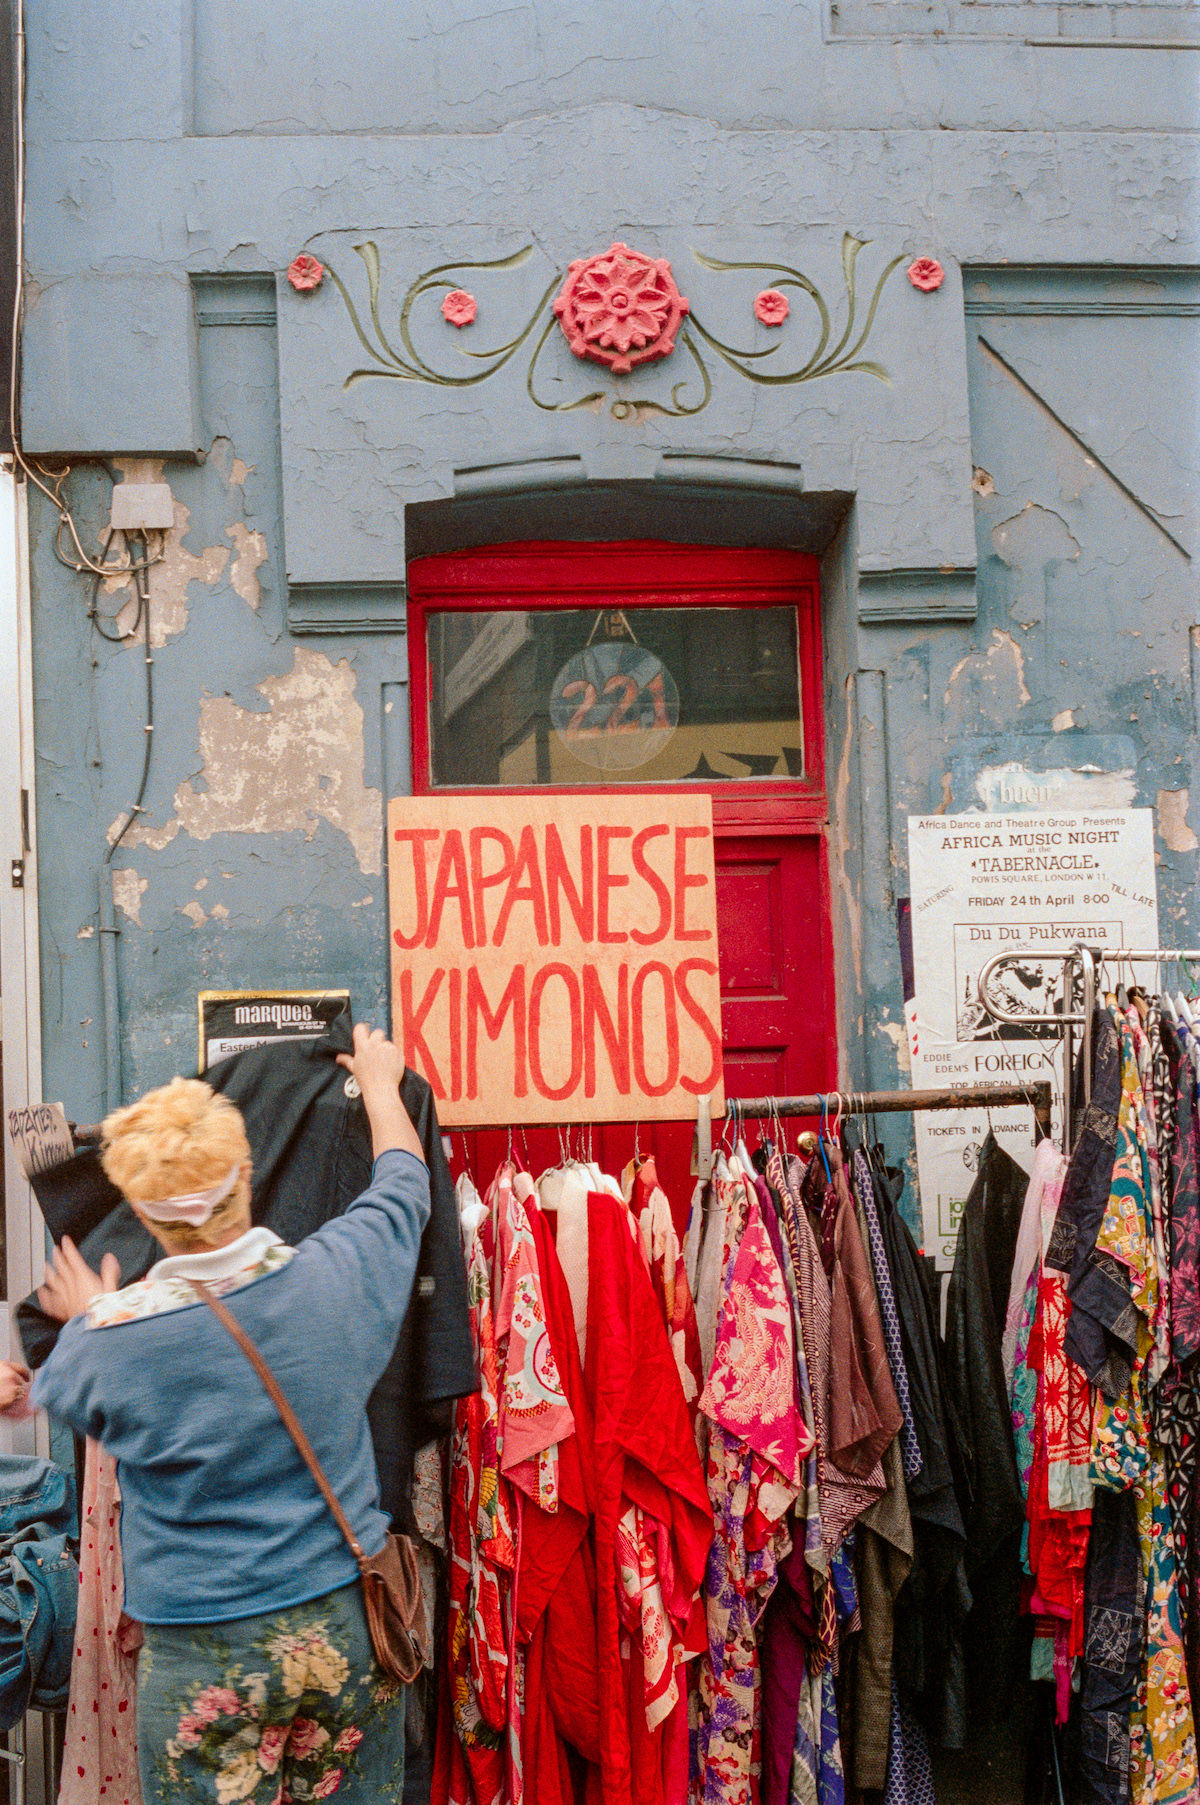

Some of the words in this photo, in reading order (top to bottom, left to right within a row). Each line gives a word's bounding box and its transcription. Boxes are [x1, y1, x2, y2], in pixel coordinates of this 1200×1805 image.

[562, 673, 671, 740] 221
[918, 820, 946, 829] Africa
[950, 819, 980, 829] Dance
[985, 819, 1002, 828] and
[1006, 818, 1045, 828] Theatre
[1047, 817, 1077, 828] Group
[1083, 816, 1126, 826] Presents
[941, 834, 1003, 849] AFRICA
[1009, 832, 1062, 847] MUSIC
[1068, 830, 1119, 844] NIGHT
[979, 854, 1093, 872] TABERNACLE
[1045, 871, 1084, 882] LONDON
[393, 823, 713, 949] JAPANESE
[968, 897, 1005, 907] FRIDAY
[1045, 895, 1075, 907] April
[1111, 882, 1127, 896] TILL
[1132, 892, 1154, 908] LATE
[969, 928, 991, 941] Du
[999, 927, 1021, 940] Du
[1029, 925, 1108, 940] Pukwana
[235, 1004, 312, 1029] marquee
[400, 957, 723, 1101] KIMONOS
[923, 1053, 952, 1062] EDDIE
[935, 1064, 969, 1073] EDEM'S
[928, 1126, 966, 1136] TICKETS
[972, 1125, 981, 1134] IN
